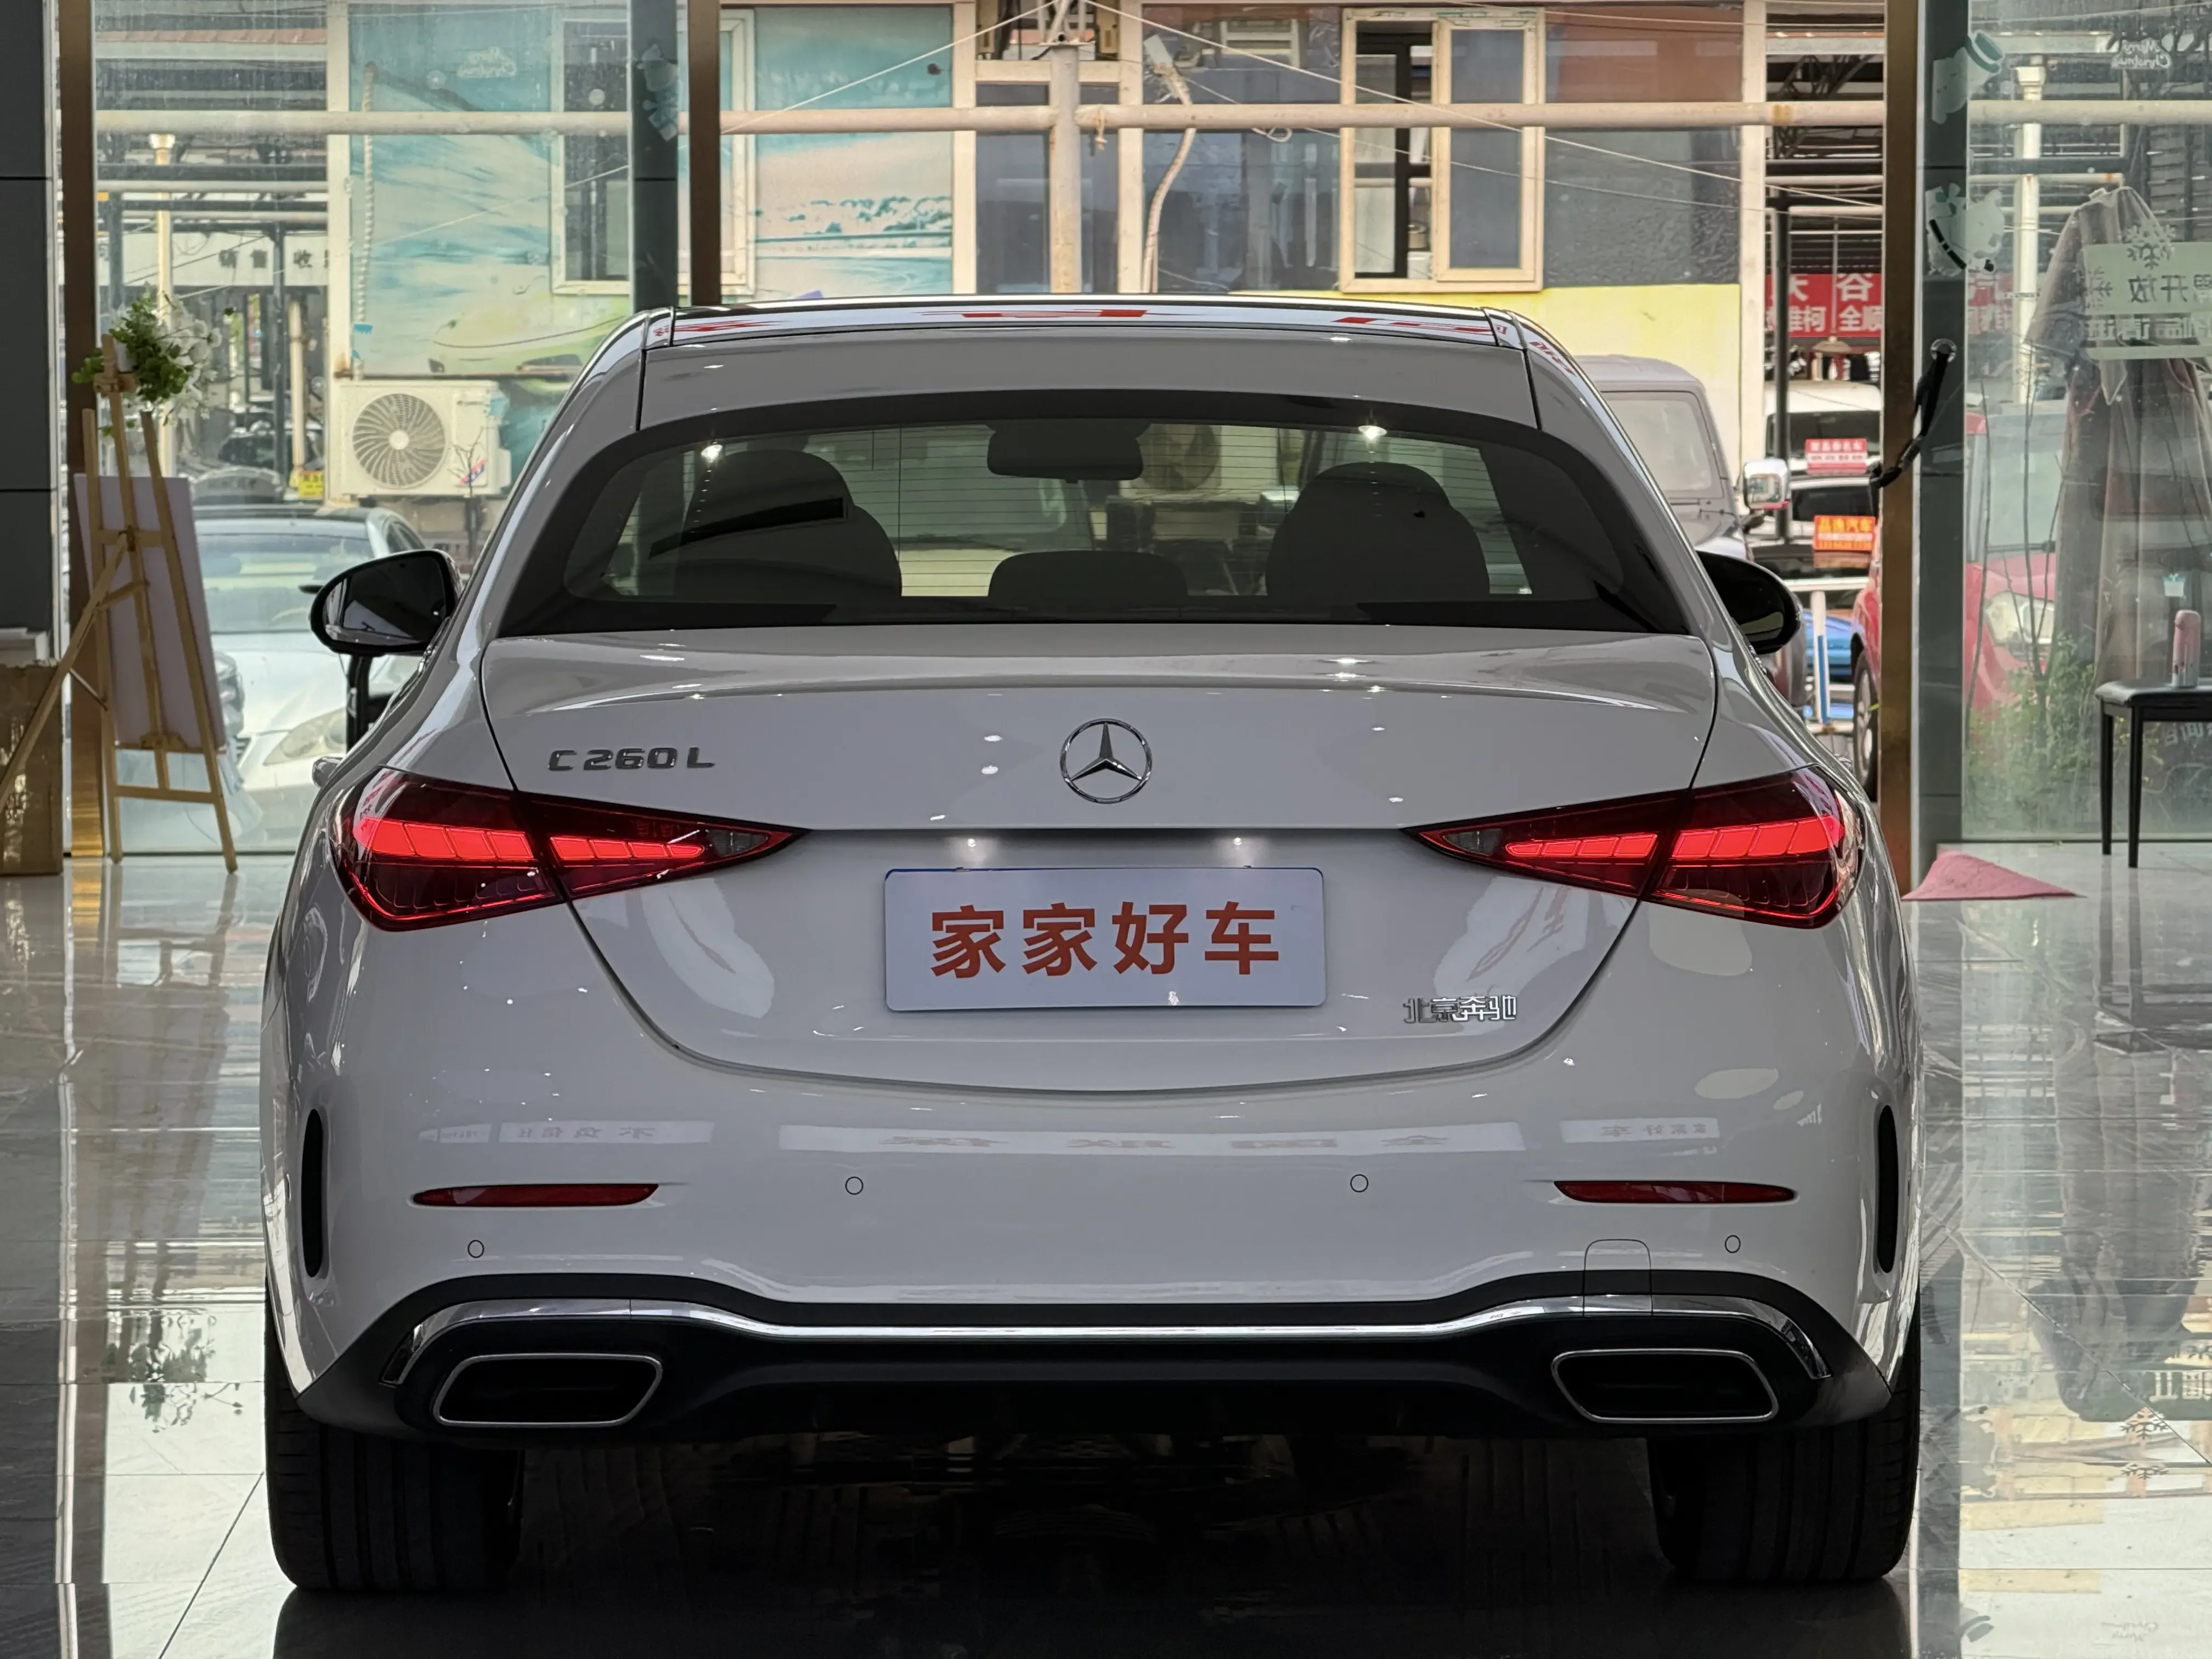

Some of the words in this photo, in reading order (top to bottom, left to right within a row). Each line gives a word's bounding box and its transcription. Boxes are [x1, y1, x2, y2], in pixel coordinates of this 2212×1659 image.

[931, 901, 1279, 979] 家家好车
[1402, 995, 1517, 1024] 北京奔驰
